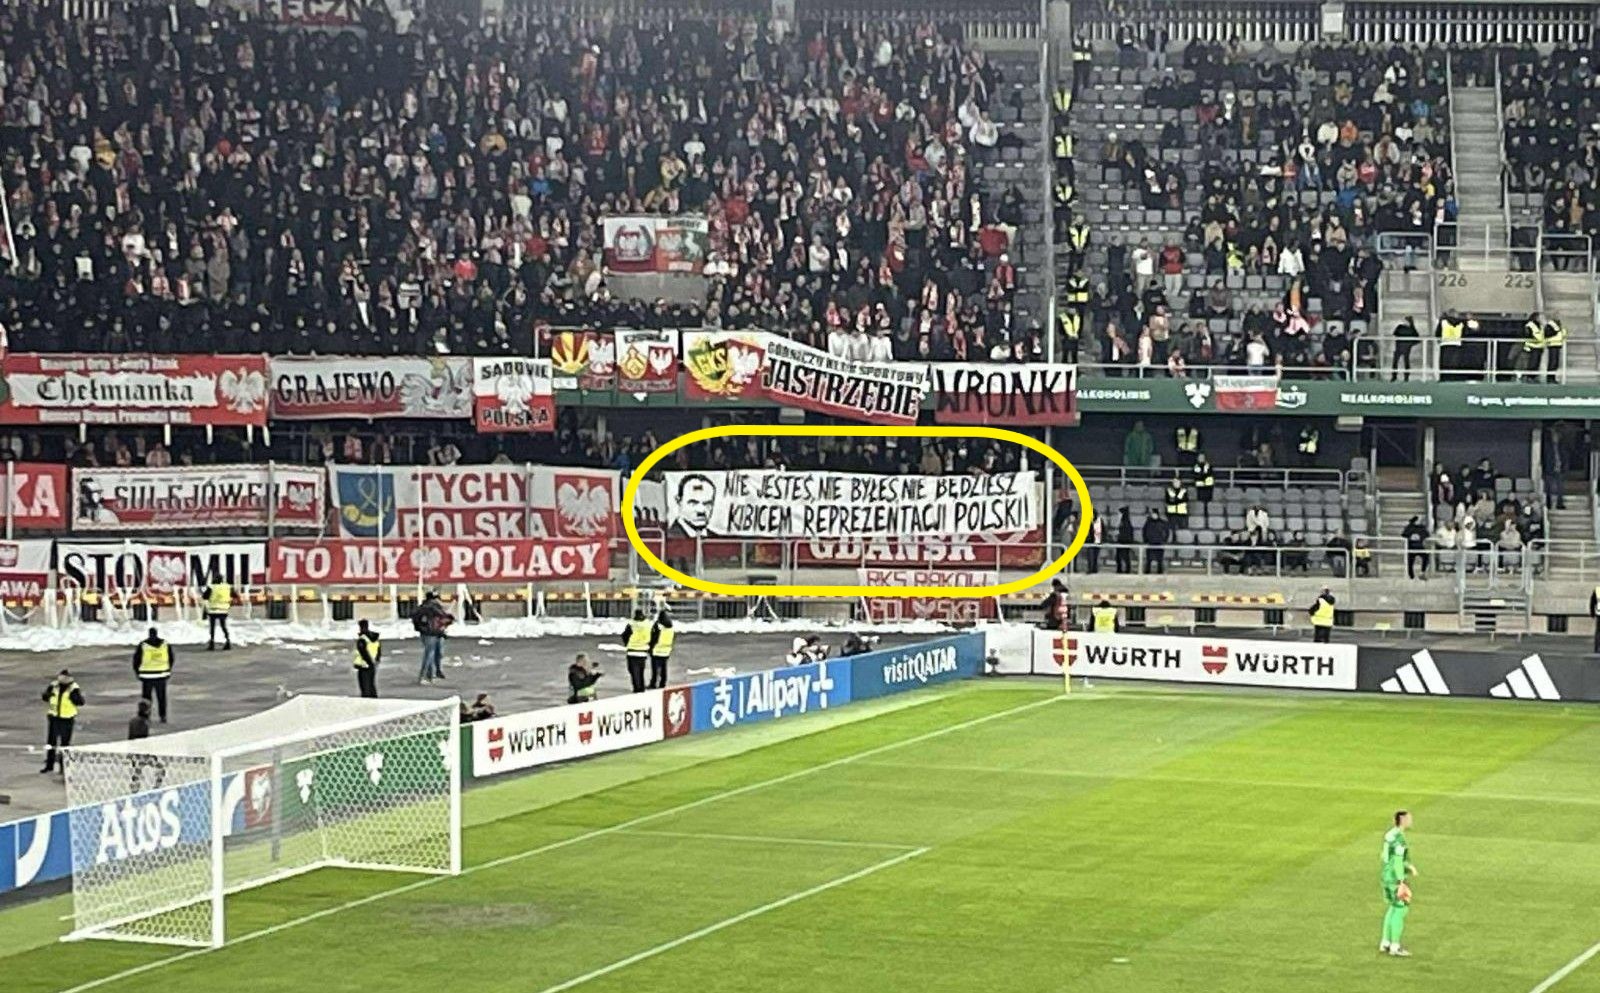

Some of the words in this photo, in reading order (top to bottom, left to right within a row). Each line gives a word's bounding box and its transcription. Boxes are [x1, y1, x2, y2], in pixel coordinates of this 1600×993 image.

[1439, 274, 1468, 287] 226
[1504, 274, 1534, 288] 225
[277, 370, 395, 404] GRAJEWO
[762, 357, 922, 416] JASTRZĘBIE
[935, 368, 1073, 418] WRONKI
[411, 473, 534, 503] TYCHY
[724, 471, 750, 496] NIE
[818, 477, 843, 500] NIE
[902, 478, 927, 501] NIE
[935, 473, 1017, 500] BĘDZIESZ
[402, 511, 549, 539] POLSKA
[727, 503, 793, 533] KIBICEM
[803, 503, 947, 535] REPREZENTACJI
[278, 545, 331, 579] TO
[343, 546, 404, 579] MY
[450, 543, 601, 578] POLACY
[1085, 644, 1181, 668] WÜRTH
[1236, 652, 1334, 676] WÜRTH
[597, 707, 652, 738] WÜRTH
[508, 722, 567, 754] WÜRTH
